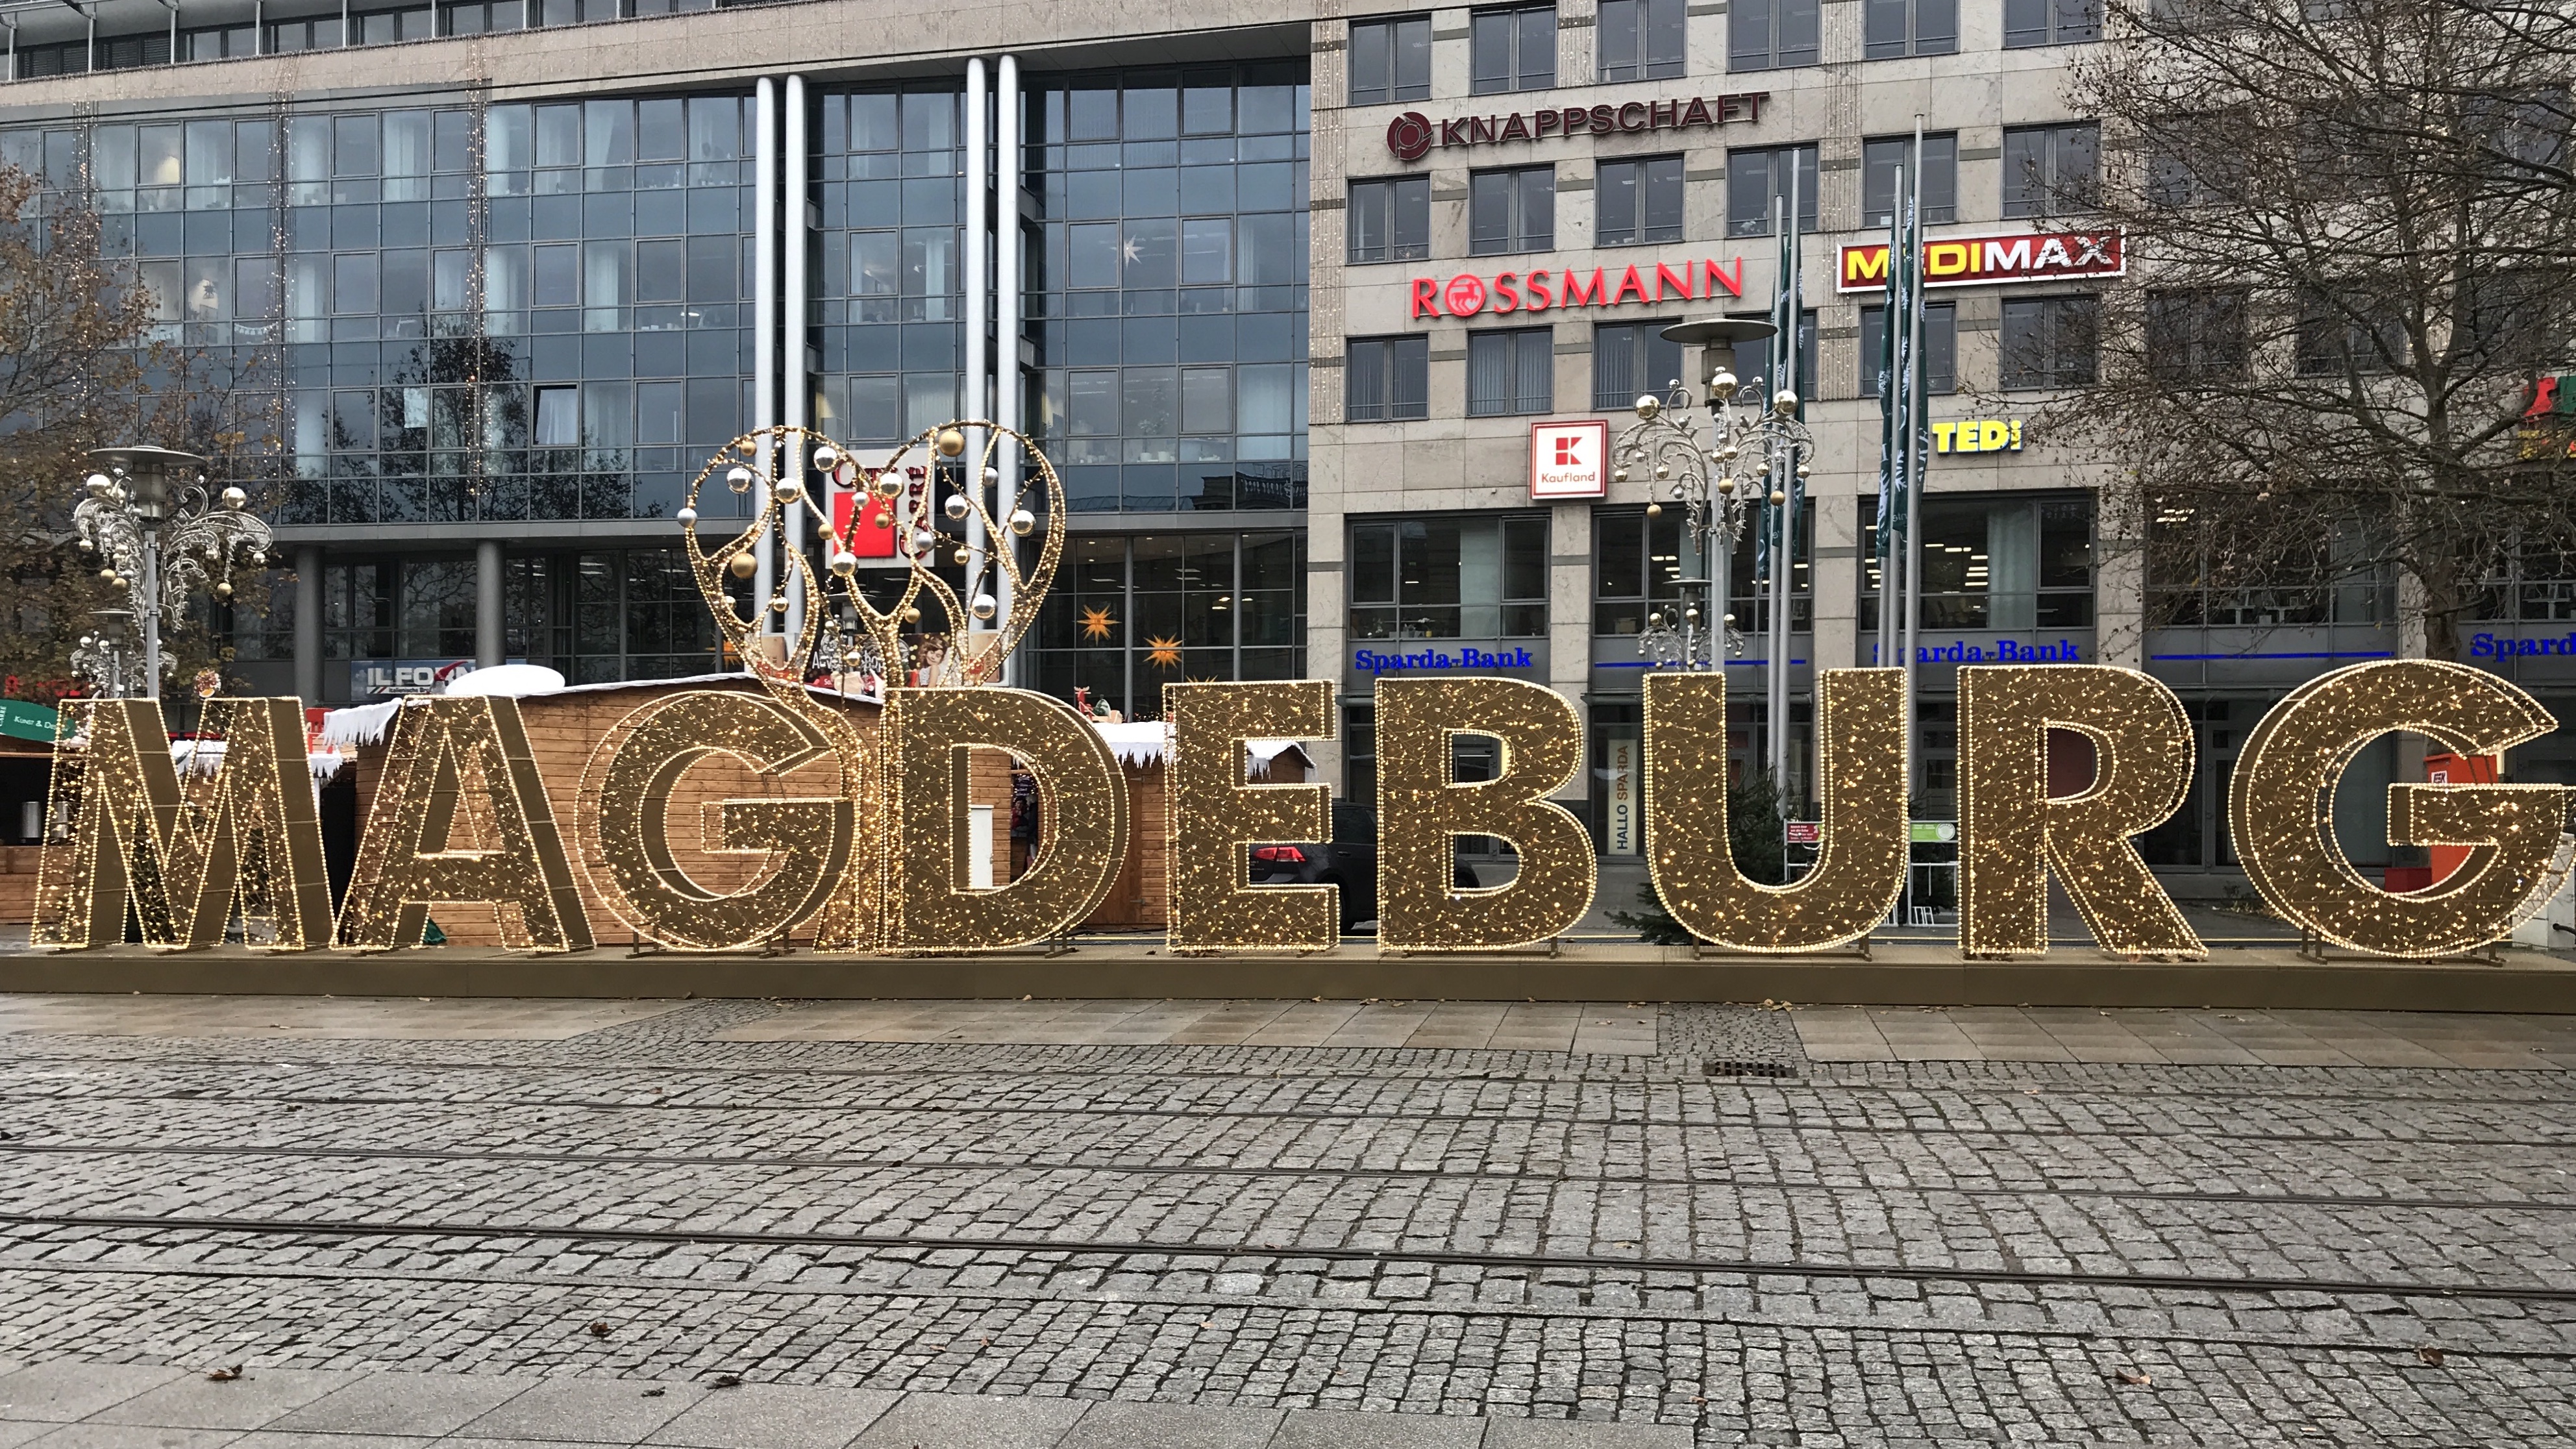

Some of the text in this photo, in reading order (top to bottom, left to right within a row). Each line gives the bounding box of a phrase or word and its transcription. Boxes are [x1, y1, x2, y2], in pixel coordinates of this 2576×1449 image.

[1441, 91, 1770, 147] KNAPPSCHAFT
[1846, 236, 2115, 281] MDIMAX
[1411, 256, 1743, 319] ROSSMANN
[1931, 419, 2024, 454] TEDi
[1541, 471, 1596, 484] Kaufland
[1355, 647, 1533, 675] Sparda-Bank
[29, 657, 2576, 960] MAGDEBURG
[1616, 745, 1629, 850] HALLO SPARDA
